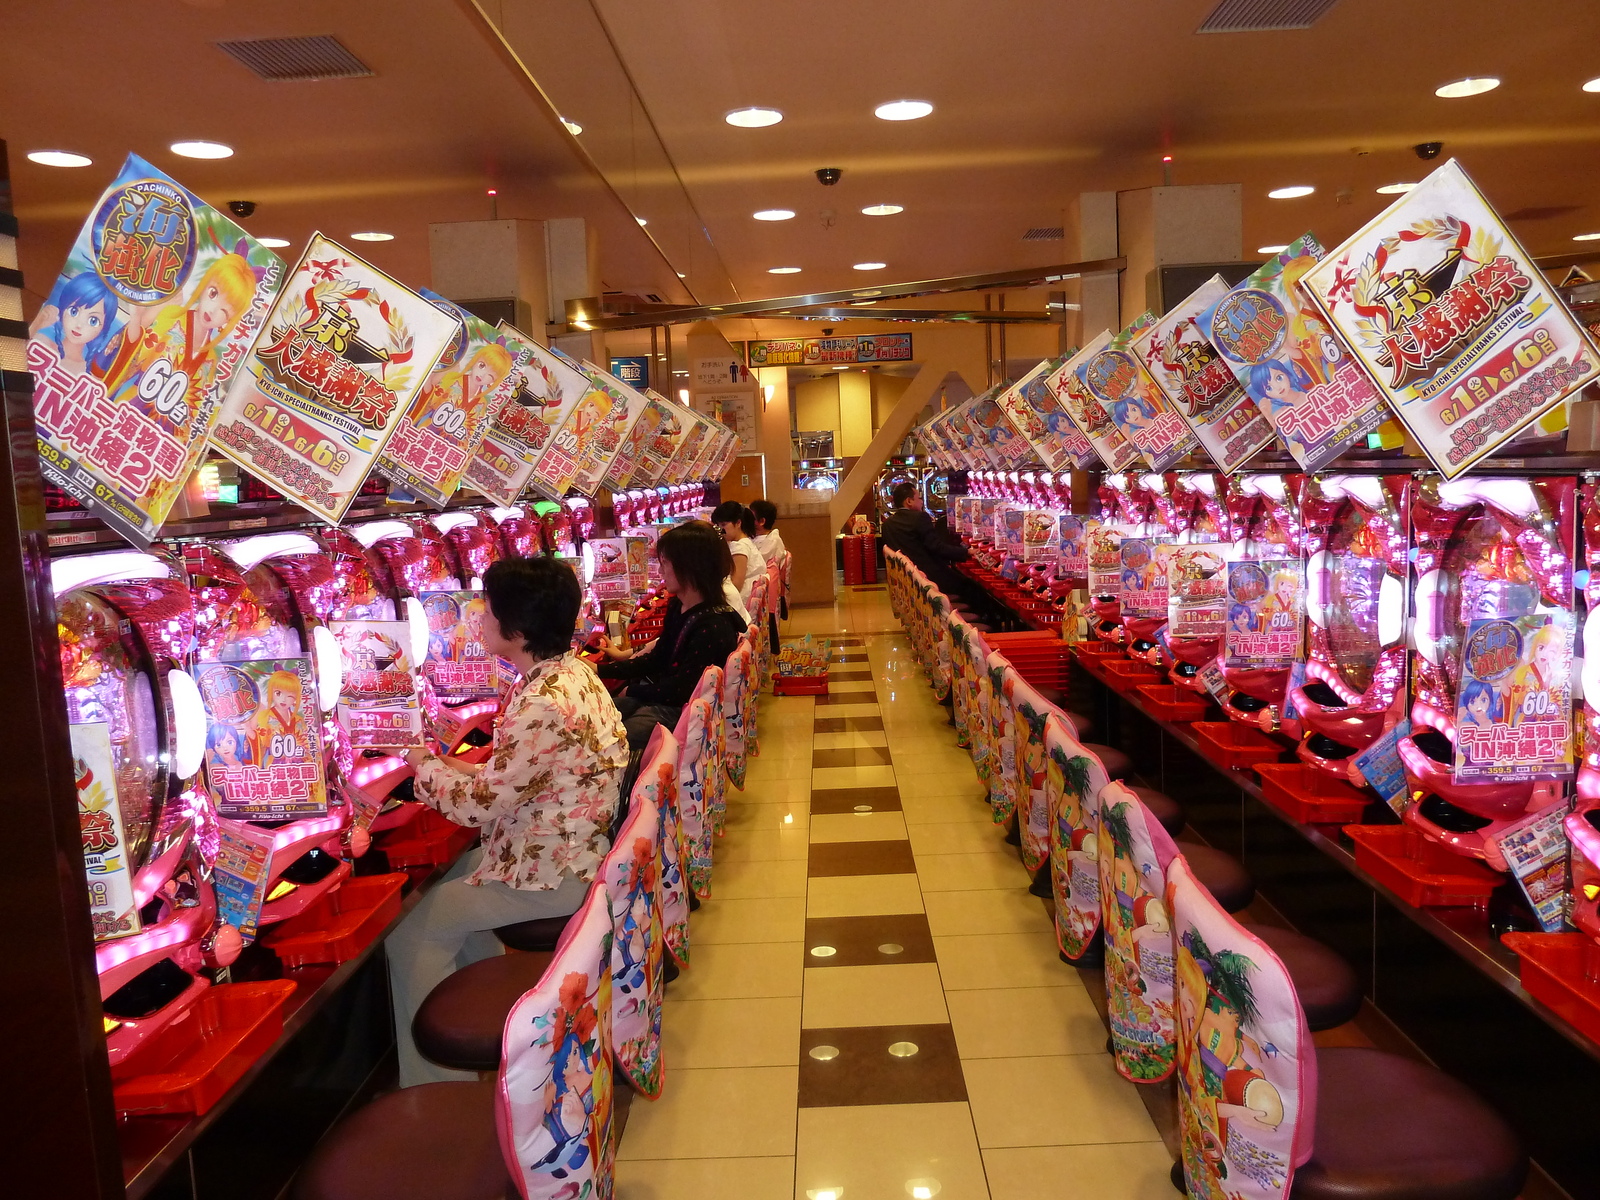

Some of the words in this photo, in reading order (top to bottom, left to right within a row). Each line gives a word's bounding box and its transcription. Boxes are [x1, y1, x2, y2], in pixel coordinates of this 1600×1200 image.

[137, 184, 181, 203] PACHINKO
[99, 231, 183, 294] 強化
[1215, 295, 1237, 323] PACHINKO
[1375, 248, 1462, 330] 京一
[302, 303, 390, 361] 京一
[1235, 307, 1285, 363] 強化
[1375, 256, 1532, 389] 大感謝祭
[257, 324, 398, 430] 大感謝祭
[620, 367, 640, 378] 階段
[1422, 373, 1452, 397] KYO-ICHI
[1450, 332, 1497, 375] SPECIALTHANKS
[1497, 306, 1525, 333] FESTIVAL
[139, 358, 188, 426] 60台
[259, 379, 285, 399] KYO-ICHI
[284, 395, 332, 421] SPECIALTHANKS
[333, 416, 361, 436] FESTIVAL
[1278, 363, 1364, 434] スーパー海
[1300, 378, 1375, 439] IN沖縄
[396, 418, 465, 470] パー海物語
[498, 400, 551, 450] 謝祭
[1134, 409, 1181, 449] スーパー
[1150, 422, 1184, 453] IN沖
[386, 432, 444, 479] 沖縄2
[1460, 722, 1567, 742] スーパー海物語
[1472, 739, 1555, 760] IN沖縄2
[212, 766, 316, 784] スーパー海物語
[228, 780, 306, 799] IN沖縄2
